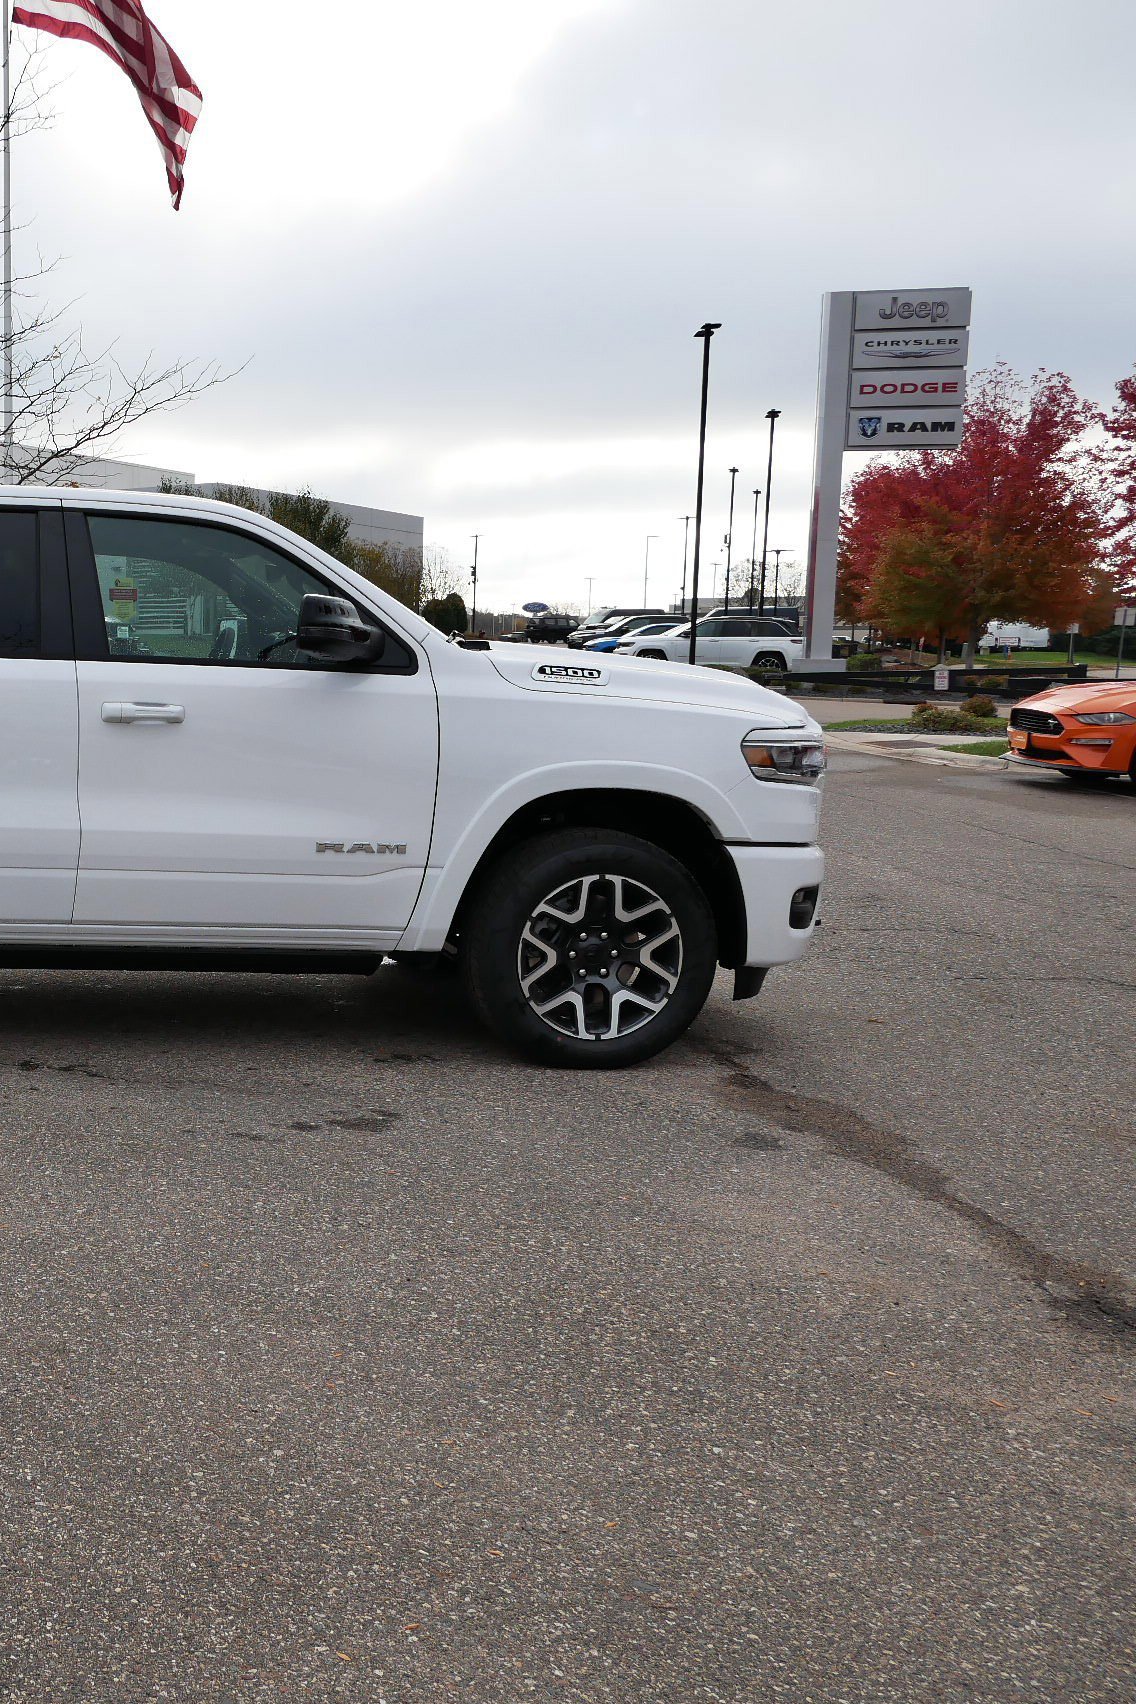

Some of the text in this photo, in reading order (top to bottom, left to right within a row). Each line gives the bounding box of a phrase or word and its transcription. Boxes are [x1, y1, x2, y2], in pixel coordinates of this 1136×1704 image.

[879, 296, 950, 323] Jeep
[864, 338, 959, 348] CHRYSLER
[859, 382, 959, 395] DODGE
[886, 421, 956, 433] RAM
[542, 666, 600, 678] 1500
[315, 841, 407, 855] RAM
